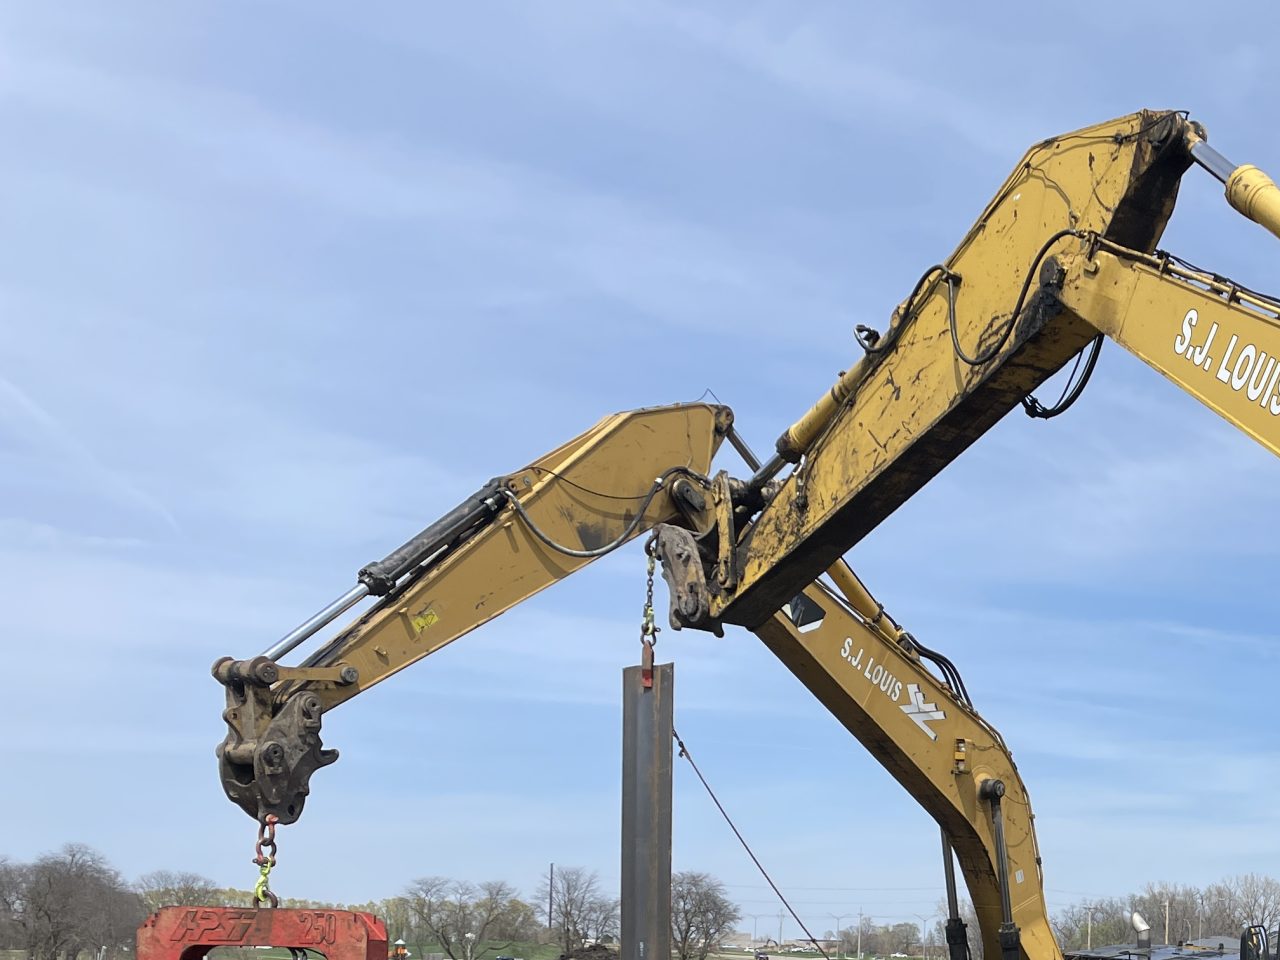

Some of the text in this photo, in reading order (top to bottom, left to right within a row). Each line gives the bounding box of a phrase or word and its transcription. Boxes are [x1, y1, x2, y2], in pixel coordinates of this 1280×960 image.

[1174, 308, 1219, 372] S.J.
[841, 637, 903, 702] S.J. LOUIS
